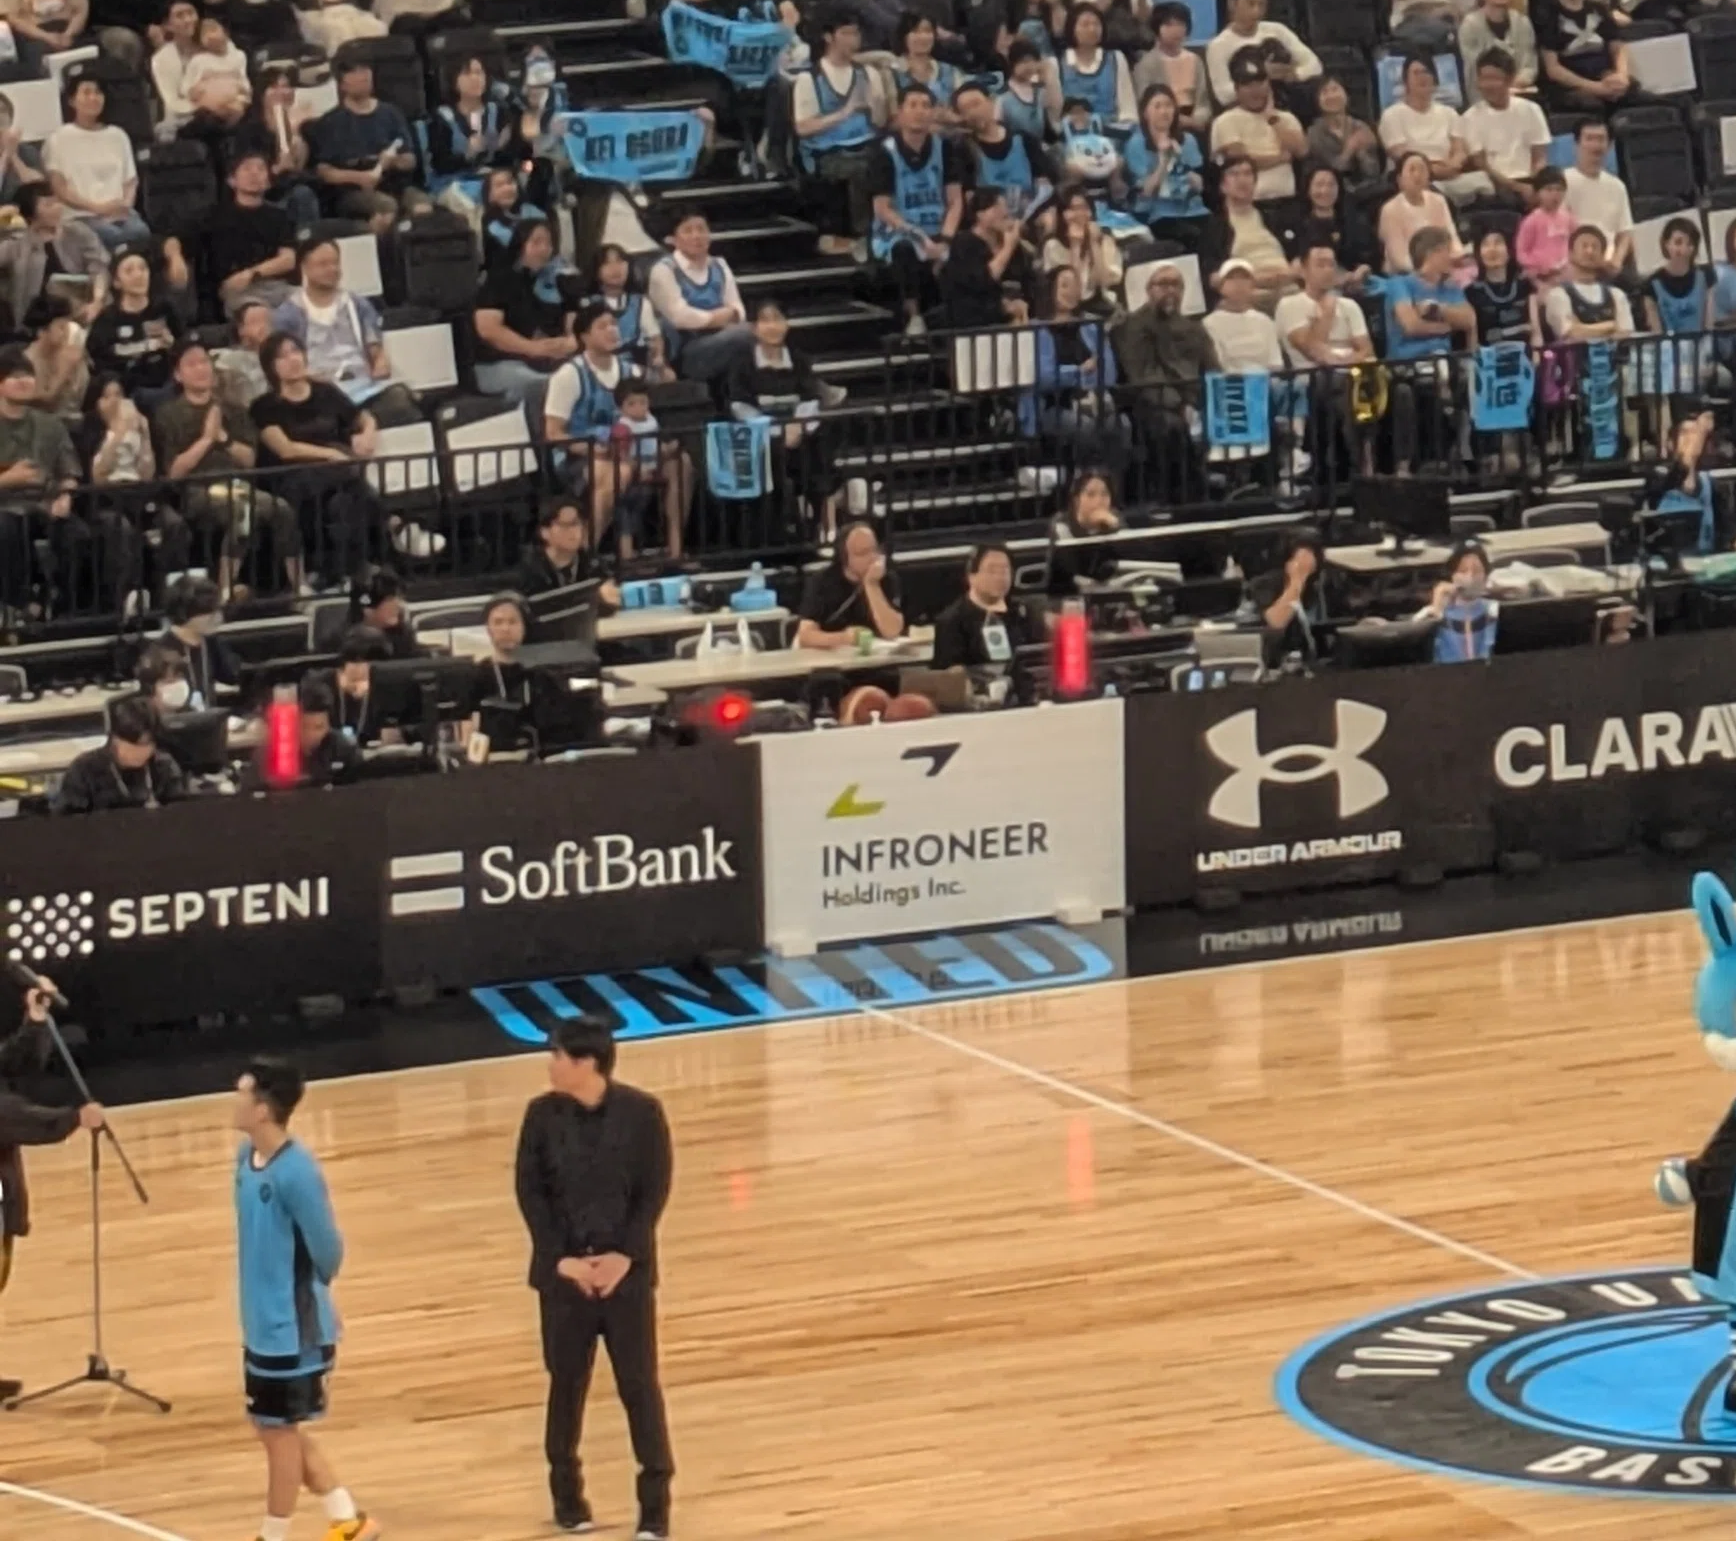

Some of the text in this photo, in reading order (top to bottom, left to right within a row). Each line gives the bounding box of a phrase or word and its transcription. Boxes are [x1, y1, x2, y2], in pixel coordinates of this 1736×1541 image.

[478, 825, 738, 905] SoftBank
[822, 821, 1049, 878] INFRONEER
[1196, 829, 1403, 873] UNDER ARMOUR
[107, 875, 331, 940] SEPTENI
[822, 876, 967, 910] Holdings Inc.
[1335, 1298, 1567, 1378] TOKYO
